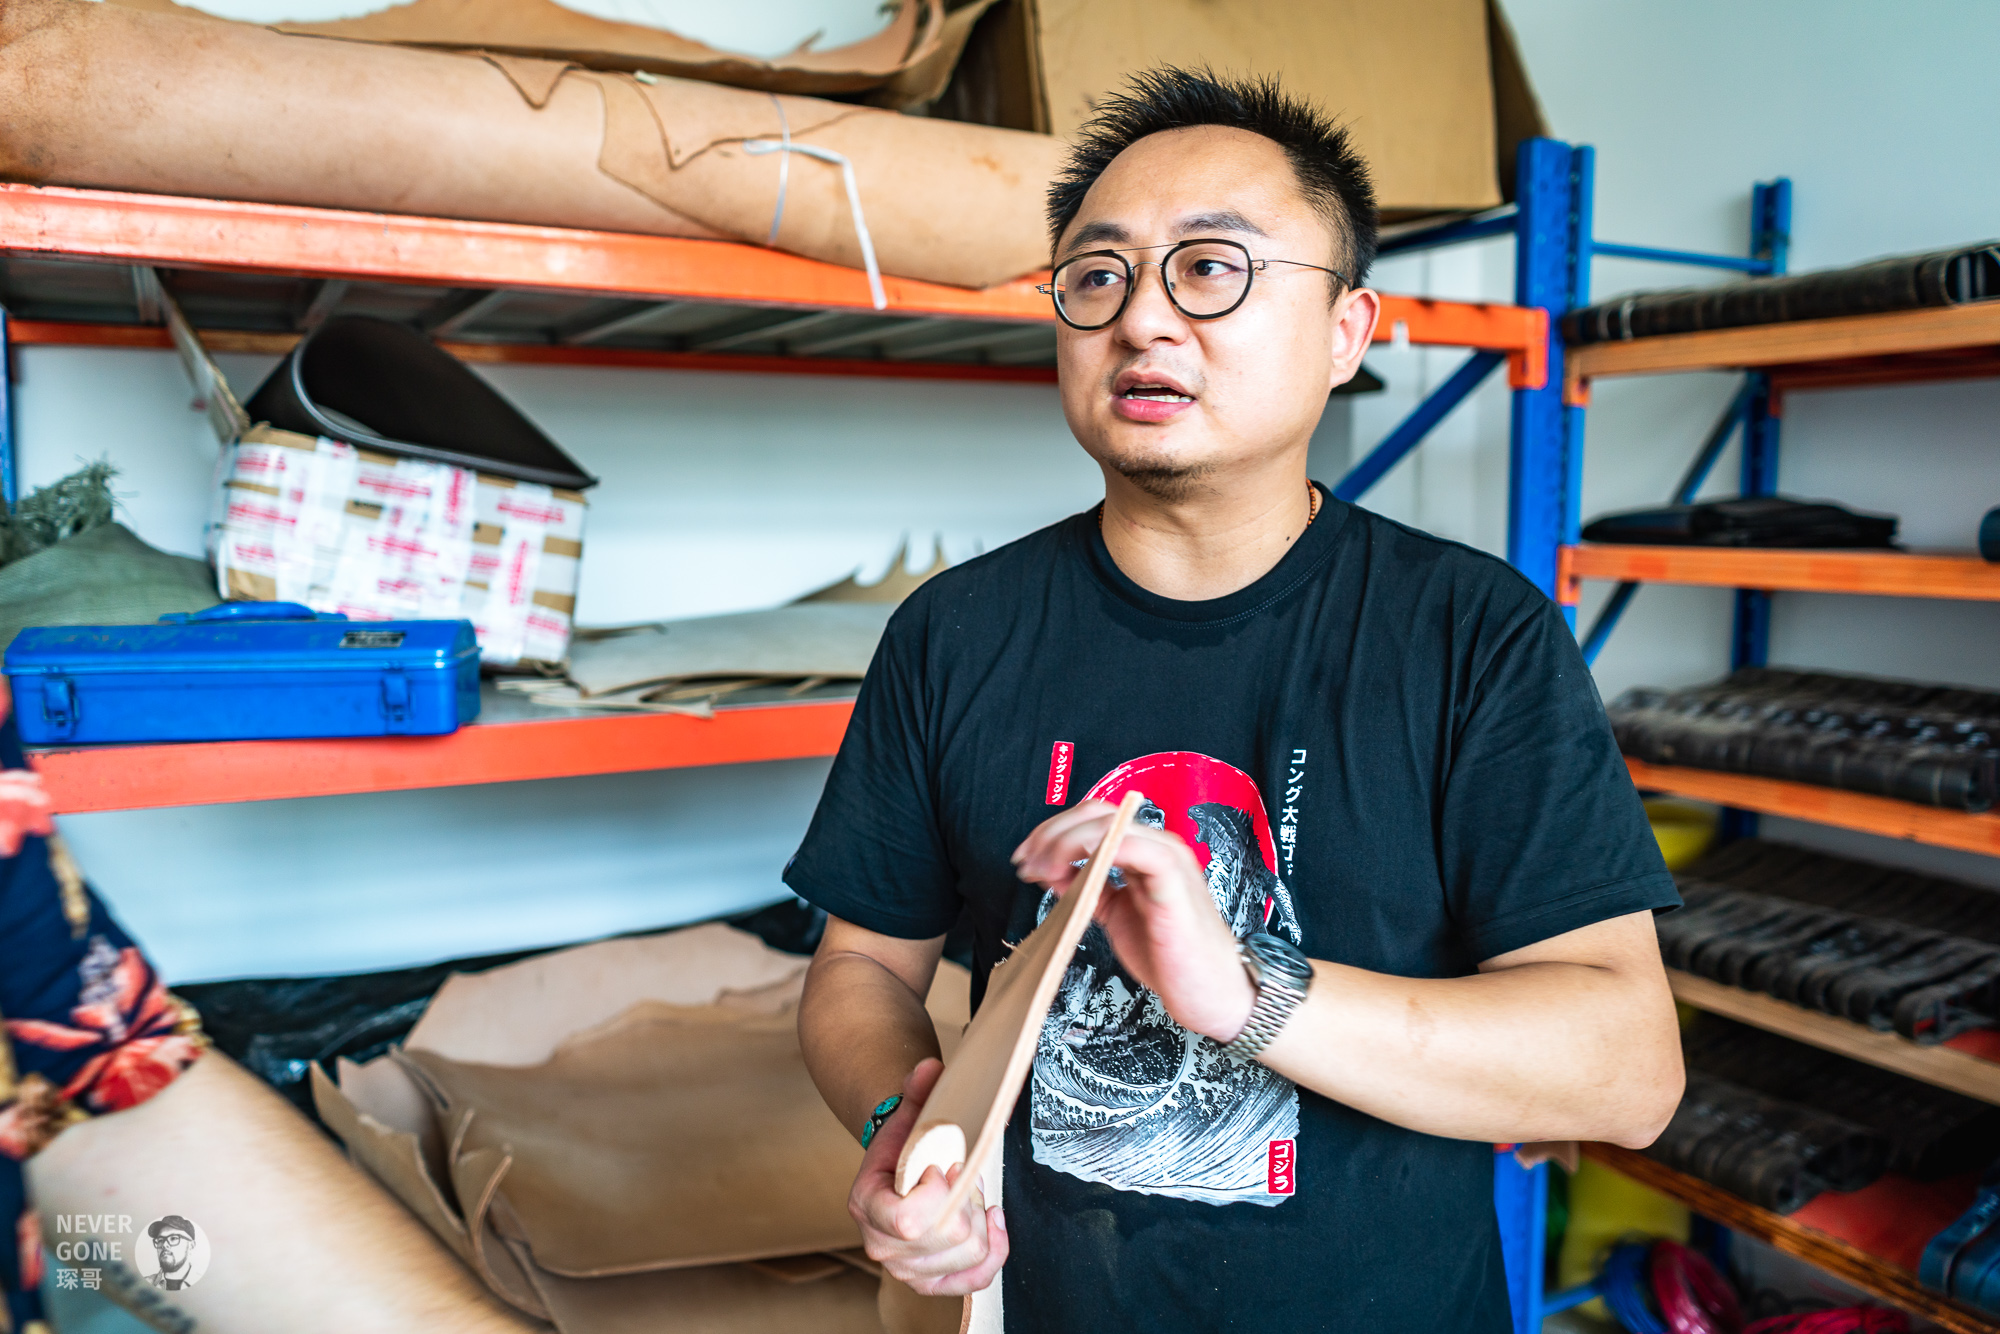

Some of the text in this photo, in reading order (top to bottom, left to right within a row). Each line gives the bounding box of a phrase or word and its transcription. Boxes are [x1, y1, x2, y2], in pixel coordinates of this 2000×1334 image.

[1052, 744, 1069, 803] キングコング
[1273, 1142, 1291, 1191] ゴジラ
